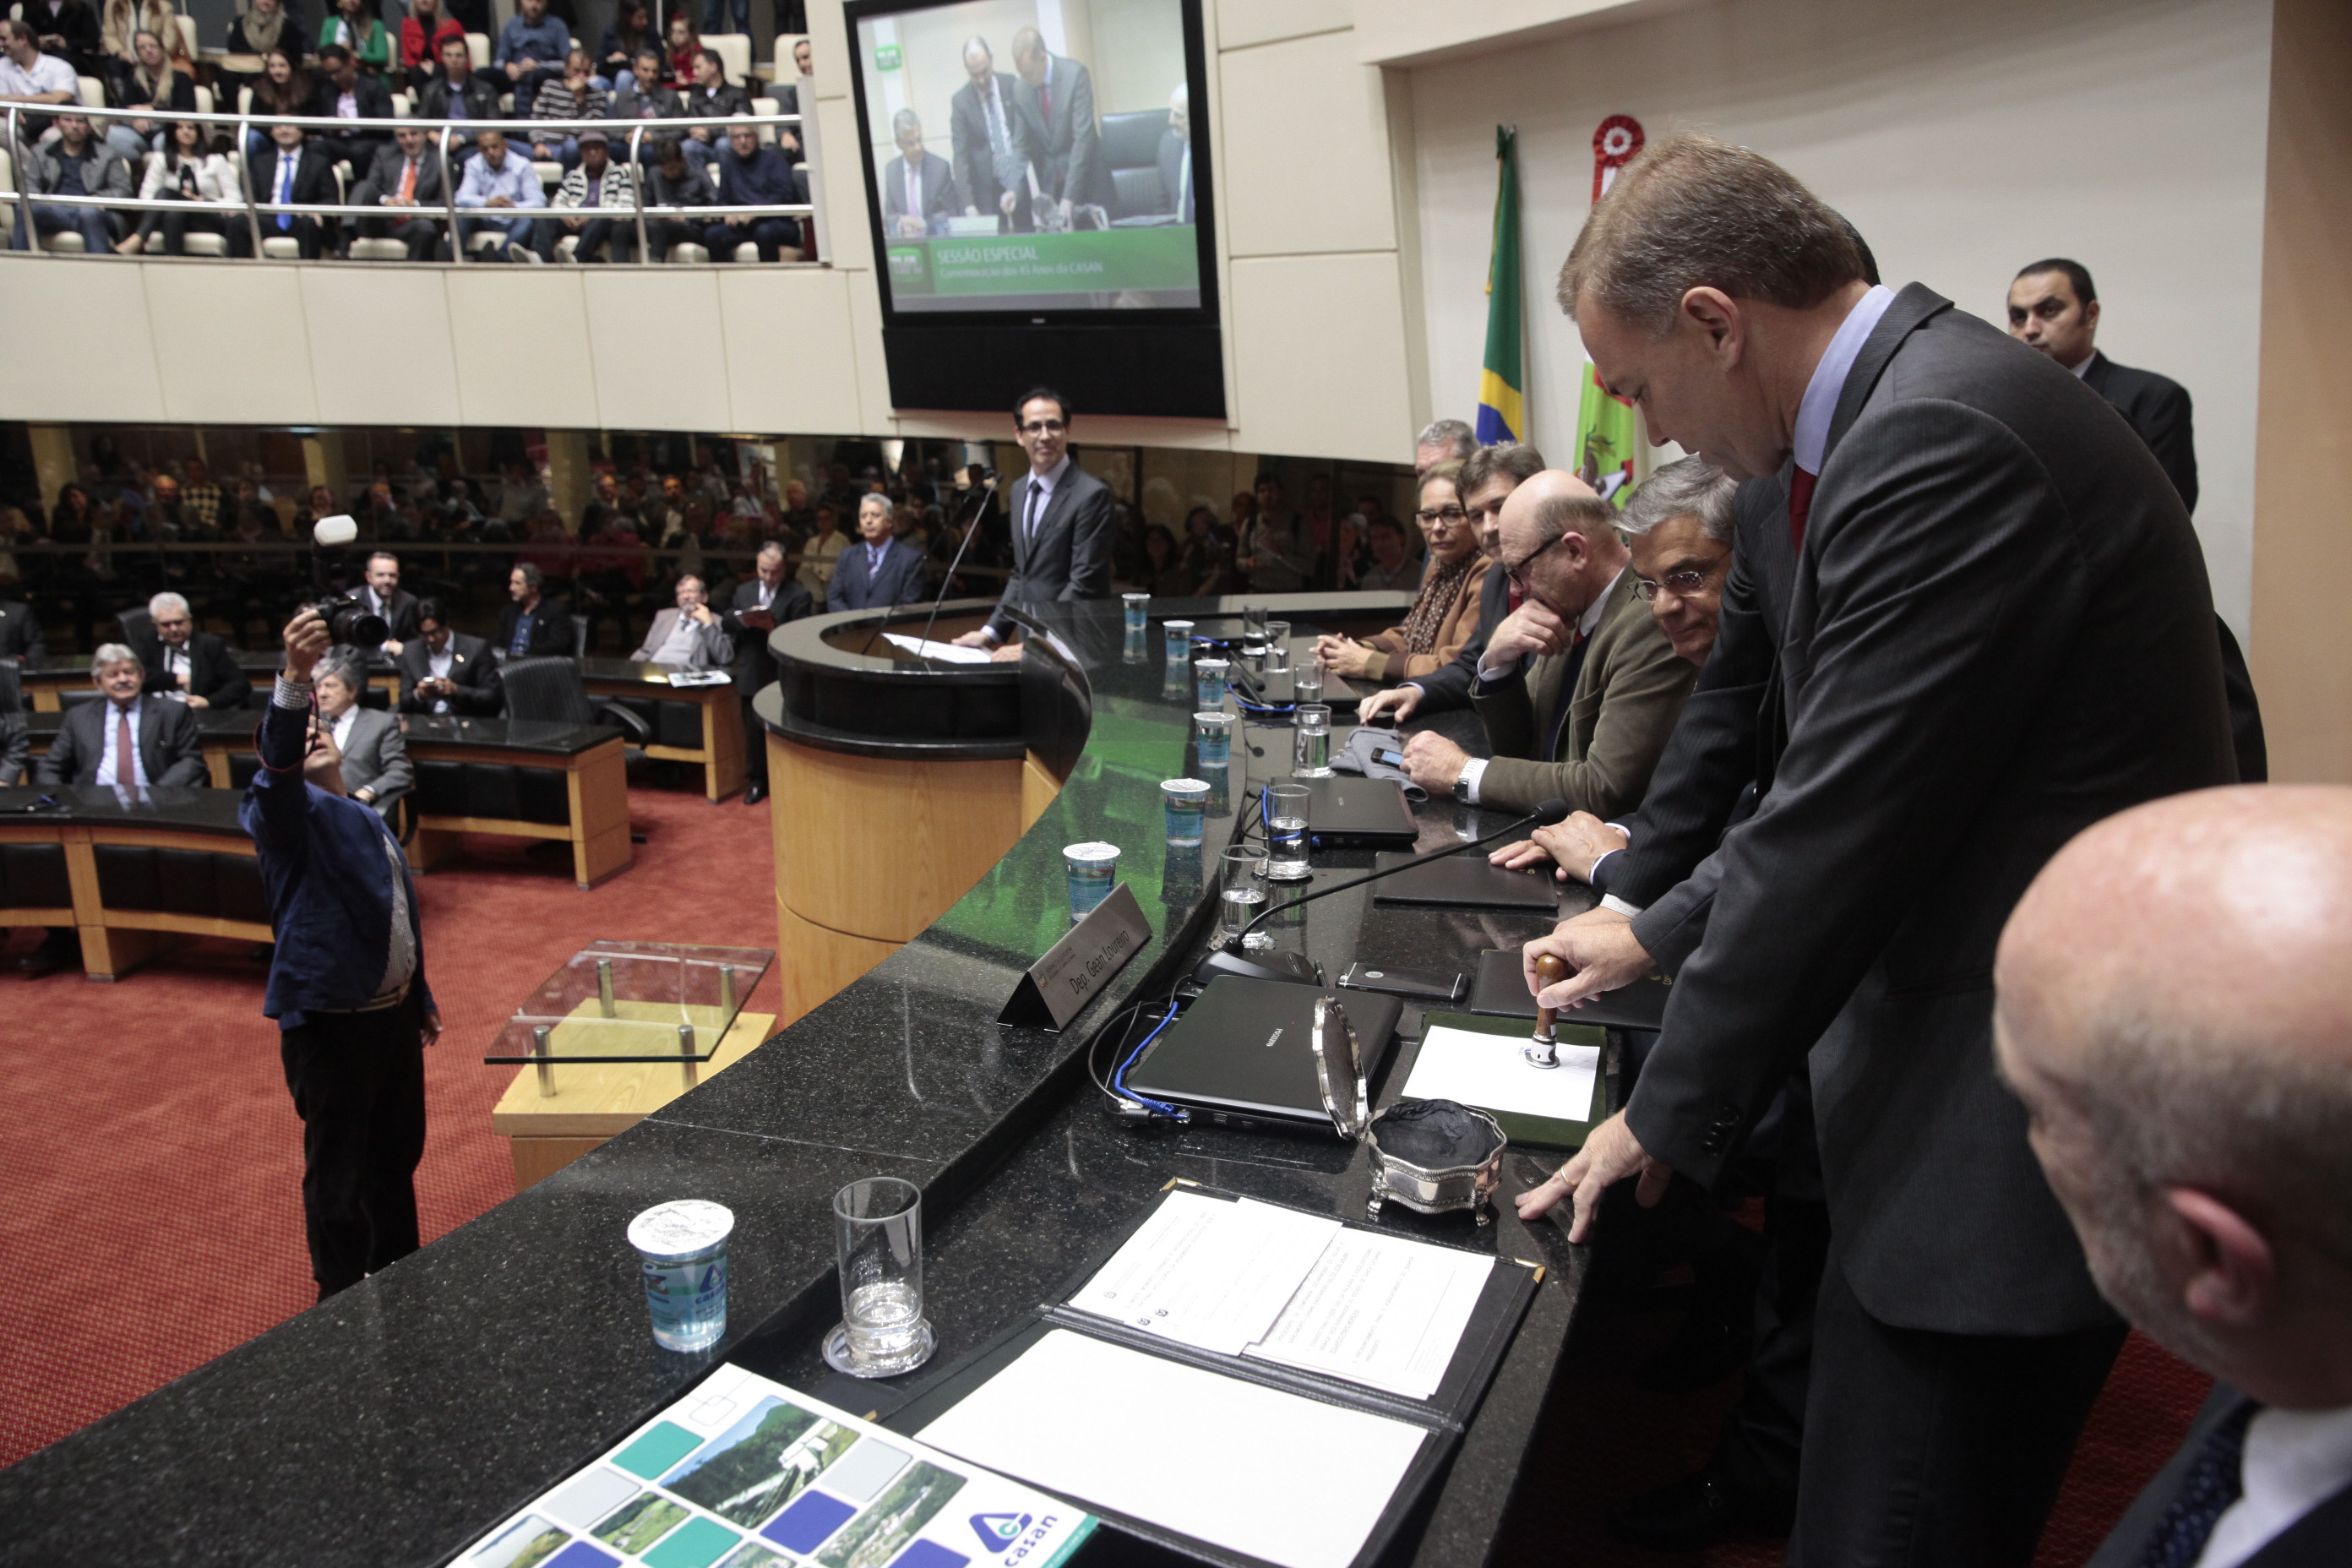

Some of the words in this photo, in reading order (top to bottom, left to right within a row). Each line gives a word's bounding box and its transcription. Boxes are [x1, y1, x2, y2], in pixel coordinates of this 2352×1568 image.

[937, 246, 982, 264] SESSÃO
[983, 246, 1039, 264] ESPECIAL
[1069, 261, 1102, 274] CASAN
[1069, 973, 1090, 994] Dep.
[1086, 954, 1108, 977] Gean
[1102, 930, 1130, 961] Loureiro
[1004, 1516, 1058, 1566] casan
